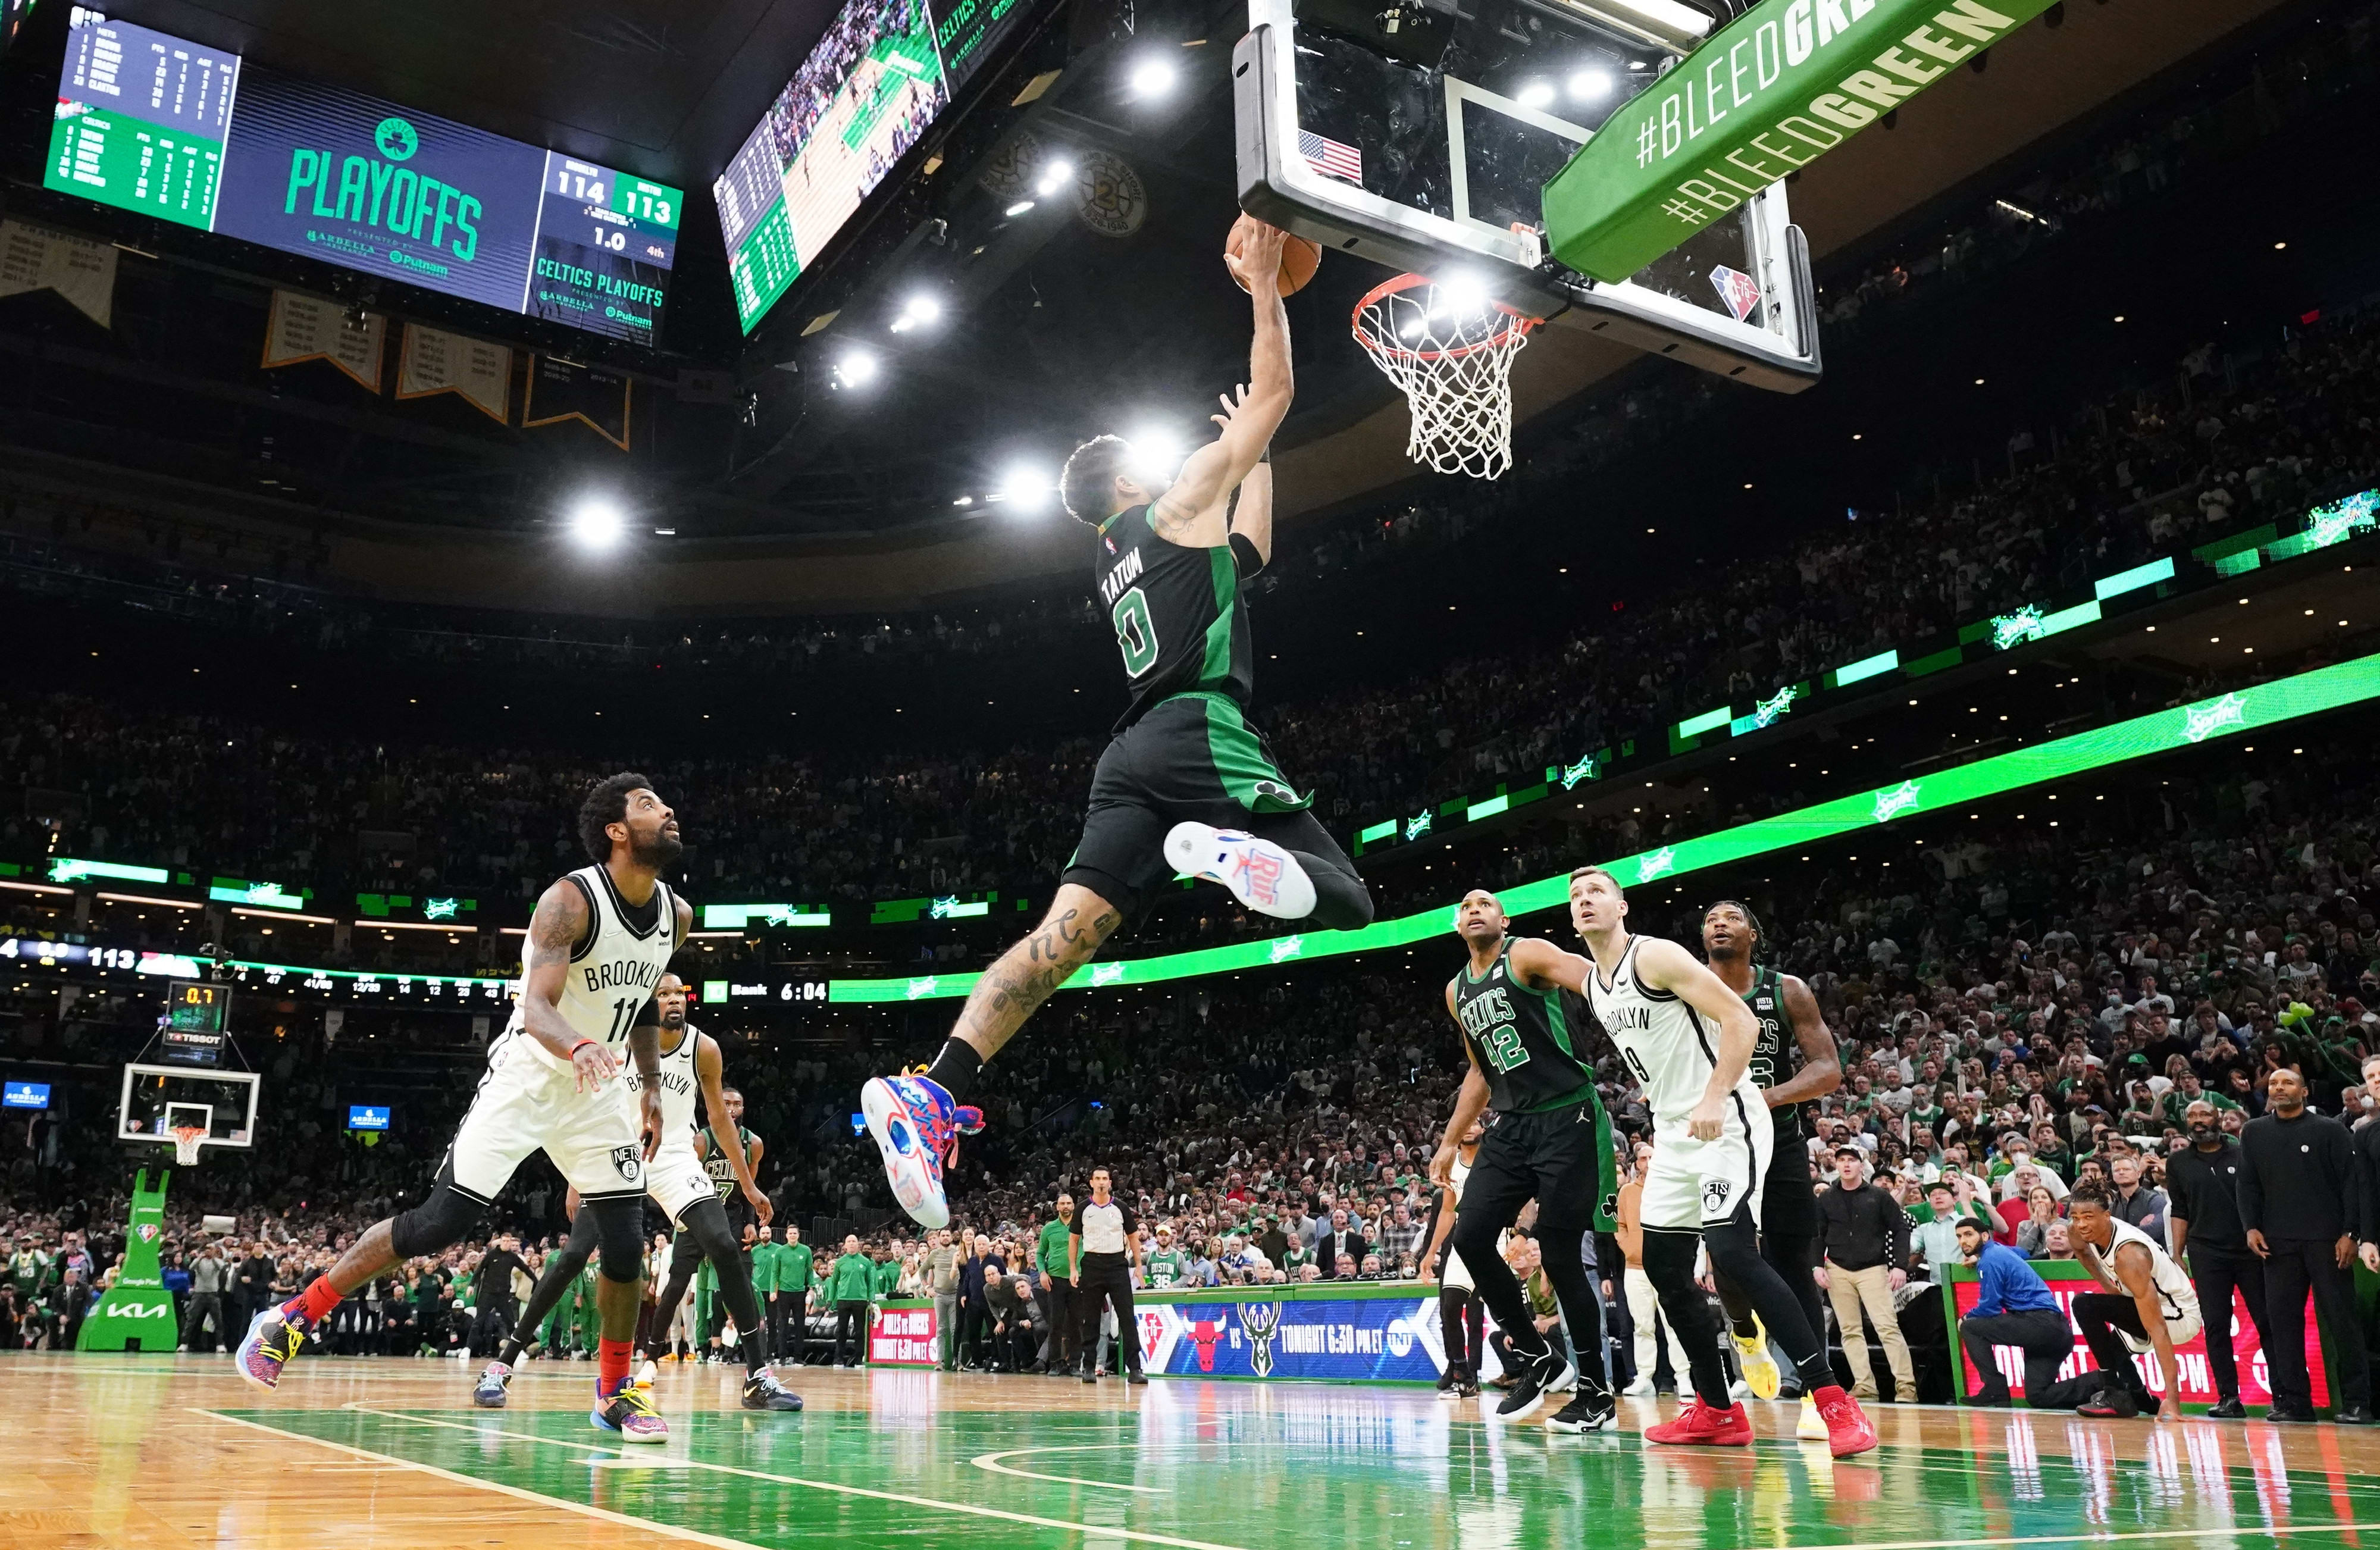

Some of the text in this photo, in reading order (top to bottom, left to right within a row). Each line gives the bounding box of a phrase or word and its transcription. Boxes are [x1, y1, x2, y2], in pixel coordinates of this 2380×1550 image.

[1661, 0, 2016, 225] #BLEEDGREEN
[559, 171, 605, 204] 114
[284, 148, 483, 262] PLAYOFFS
[627, 192, 671, 223] 113
[318, 231, 375, 253] ARBELLA
[595, 227, 625, 251] 1.0
[647, 246, 665, 258] 4th
[403, 255, 448, 275] Putnam
[537, 258, 663, 307] CELTICS PLAYOFFS
[548, 292, 594, 310] ARBELLA
[616, 310, 652, 327] Putnam
[1101, 546, 1144, 605] TATUM
[1113, 586, 1158, 679] 0
[2192, 706, 2238, 733] Sprite
[87, 947, 135, 969] 113
[267, 975, 281, 984] 47
[399, 984, 410, 994] 14
[429, 986, 441, 995] 12
[584, 960, 663, 992] BROOKLY
[186, 987, 213, 1004] 0.7
[707, 985, 725, 999] TD
[731, 984, 768, 995] Bank
[781, 982, 826, 1001] 6:04
[1755, 997, 1774, 1005] VISTA
[606, 997, 638, 1042] 11
[1460, 987, 1517, 1041] CELTICS
[1605, 1006, 1650, 1038] ROOKLYN
[183, 1034, 221, 1044] TISSOT
[1480, 1023, 1531, 1075] 42
[1625, 1046, 1650, 1083] 9
[613, 1145, 641, 1164] NETS
[715, 1182, 735, 1206] 7
[1702, 1181, 1730, 1197] NETS
[1151, 1263, 1175, 1275] BOSTON
[1153, 1274, 1172, 1289] 36
[883, 1313, 901, 1335] BULLS
[873, 1338, 897, 1360] TONIGHT
[897, 1338, 913, 1360] 6:30
[1229, 1327, 1241, 1349] VS
[1280, 1324, 1383, 1354] TONIGHT 6:30 PM ET
